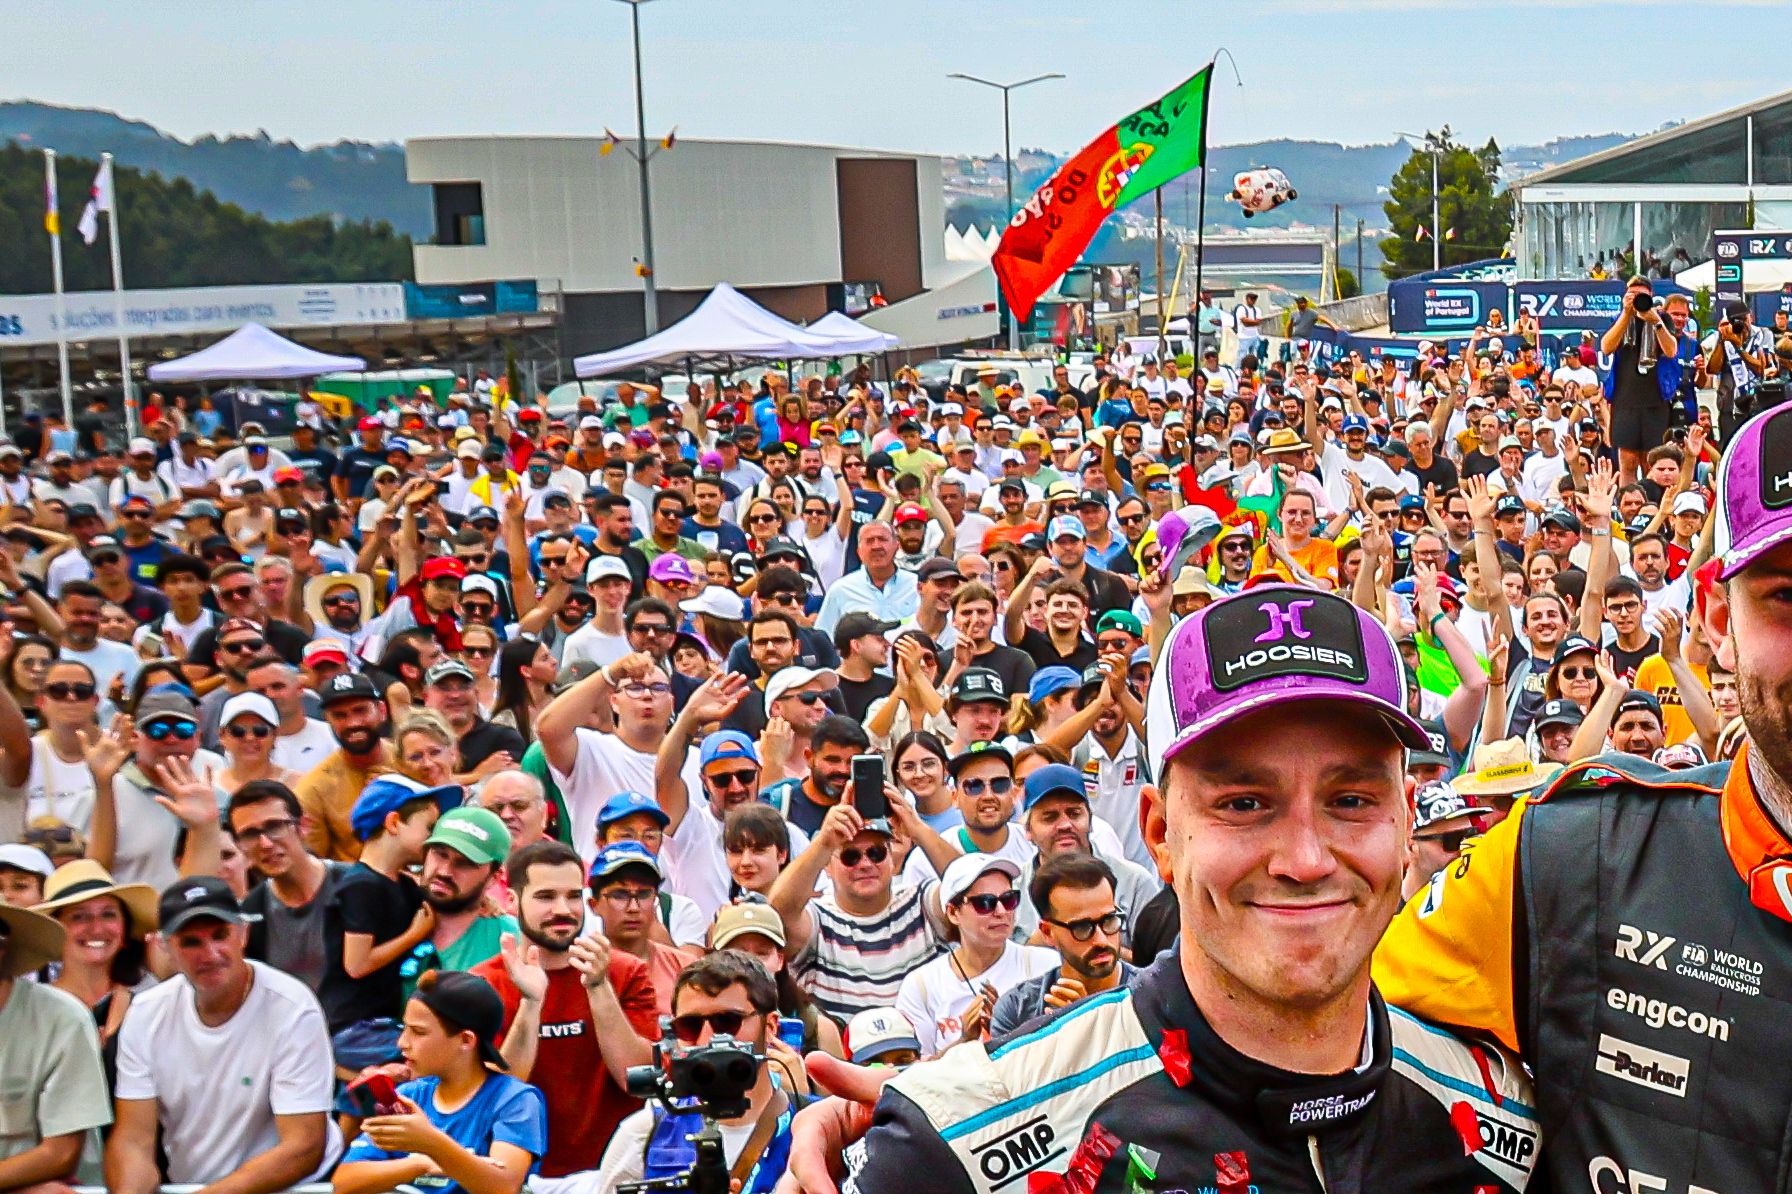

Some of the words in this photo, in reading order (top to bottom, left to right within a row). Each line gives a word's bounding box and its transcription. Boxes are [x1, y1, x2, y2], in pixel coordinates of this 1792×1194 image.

[1225, 645, 1355, 677] HOOSIER
[1614, 924, 1677, 972] RX
[1713, 949, 1764, 976] WORLD
[1675, 964, 1761, 997] CHAMPIONSHIP
[1710, 963, 1761, 986] RALLYCROSS
[1606, 988, 1731, 1042] engcon
[1614, 1052, 1686, 1093] Parker
[1292, 1094, 1345, 1112] HORSE
[980, 1121, 1056, 1182] OMP
[1478, 1119, 1534, 1163] OMP
